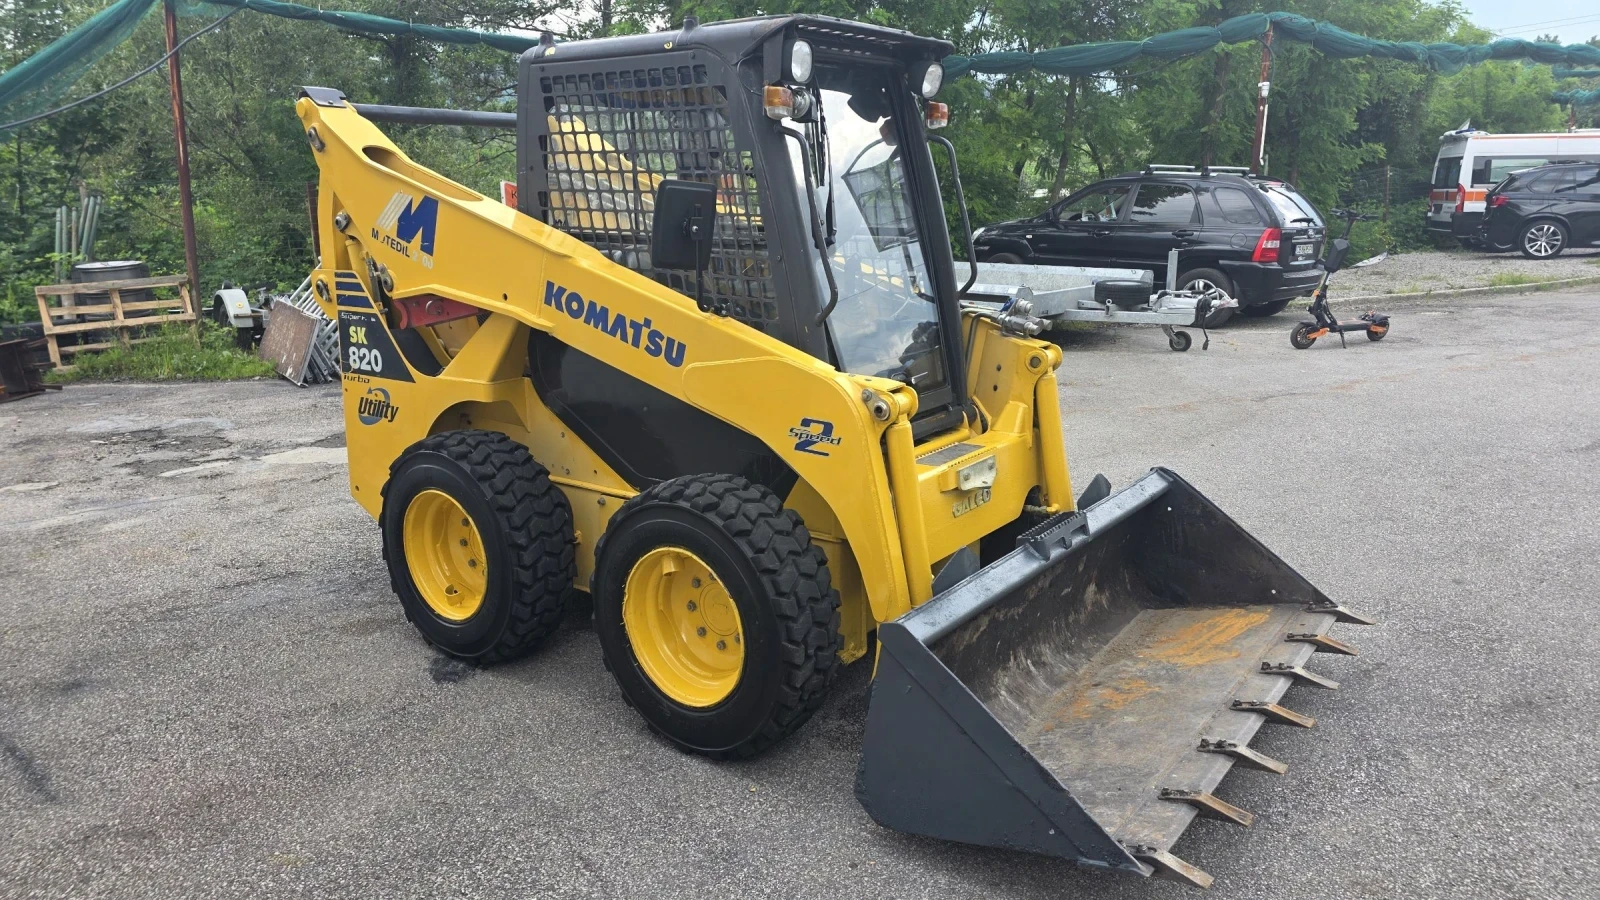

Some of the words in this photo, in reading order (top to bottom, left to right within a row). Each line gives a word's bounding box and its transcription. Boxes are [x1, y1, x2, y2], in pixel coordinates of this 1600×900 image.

[349, 325, 368, 344] SK
[544, 280, 687, 367] KOMATSU
[348, 346, 382, 372] 820
[358, 396, 400, 423] Utility
[794, 417, 834, 457] 2
